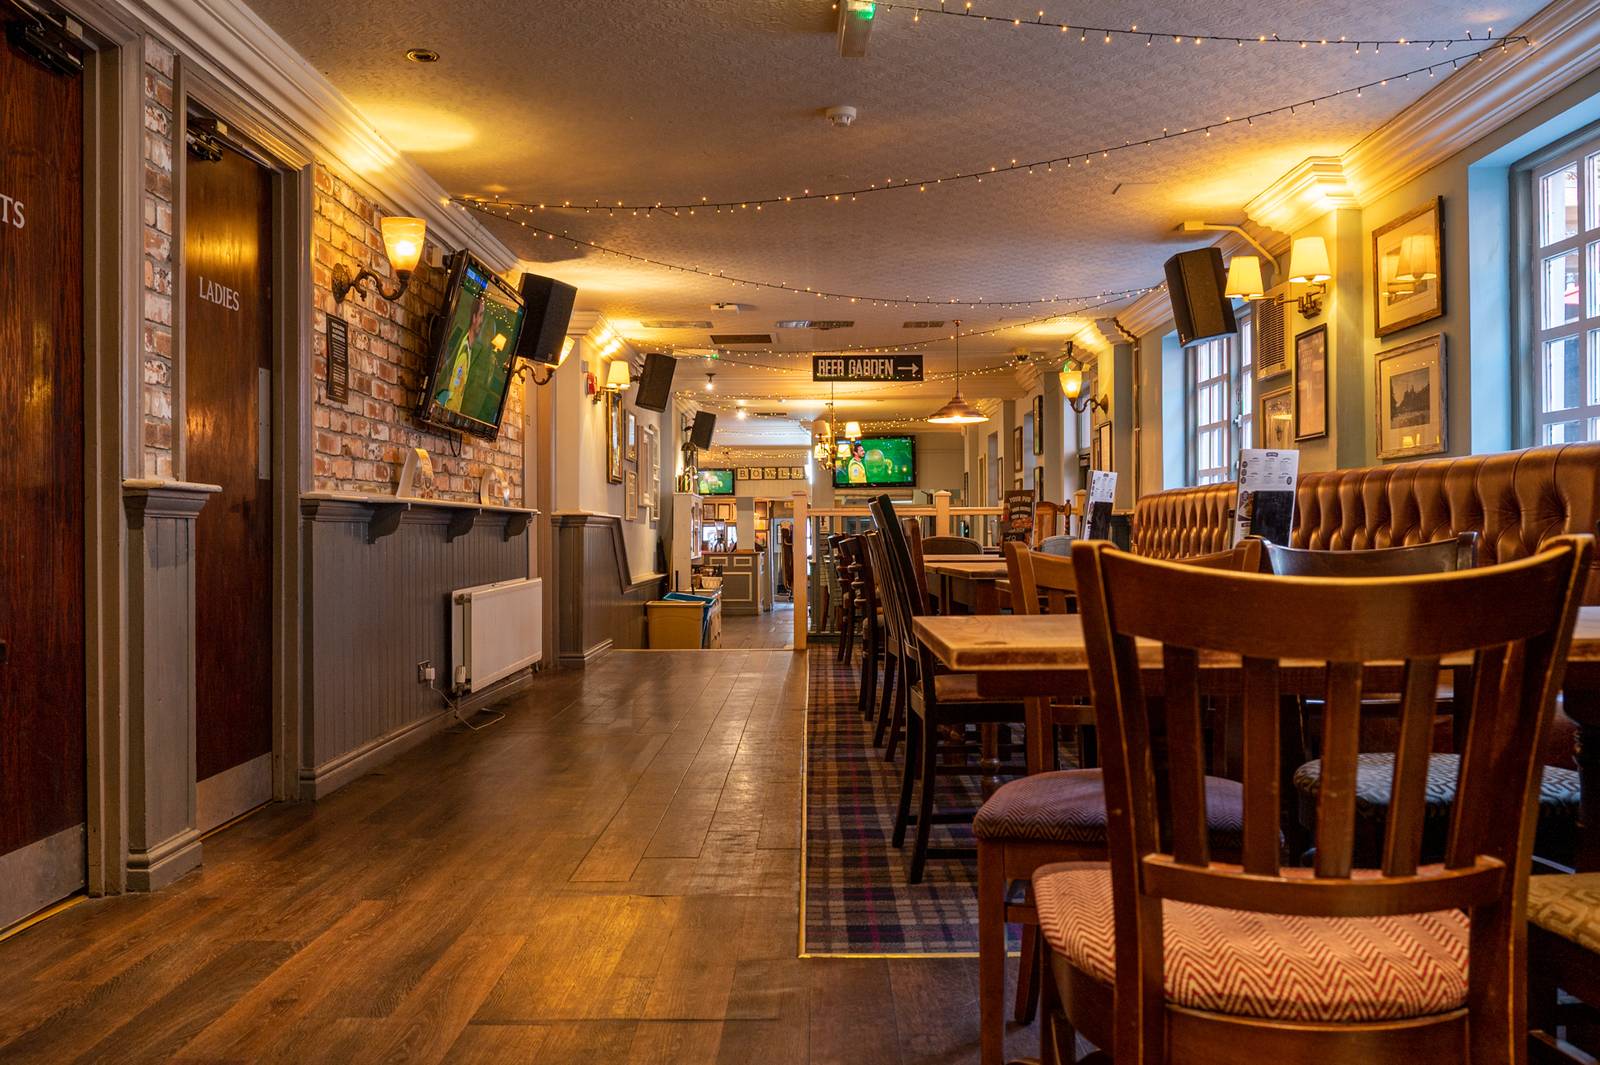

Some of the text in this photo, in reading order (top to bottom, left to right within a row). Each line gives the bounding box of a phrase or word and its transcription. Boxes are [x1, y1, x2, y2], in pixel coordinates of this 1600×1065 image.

[199, 276, 240, 311] LADIES
[818, 359, 894, 377] BEER GARDEN
